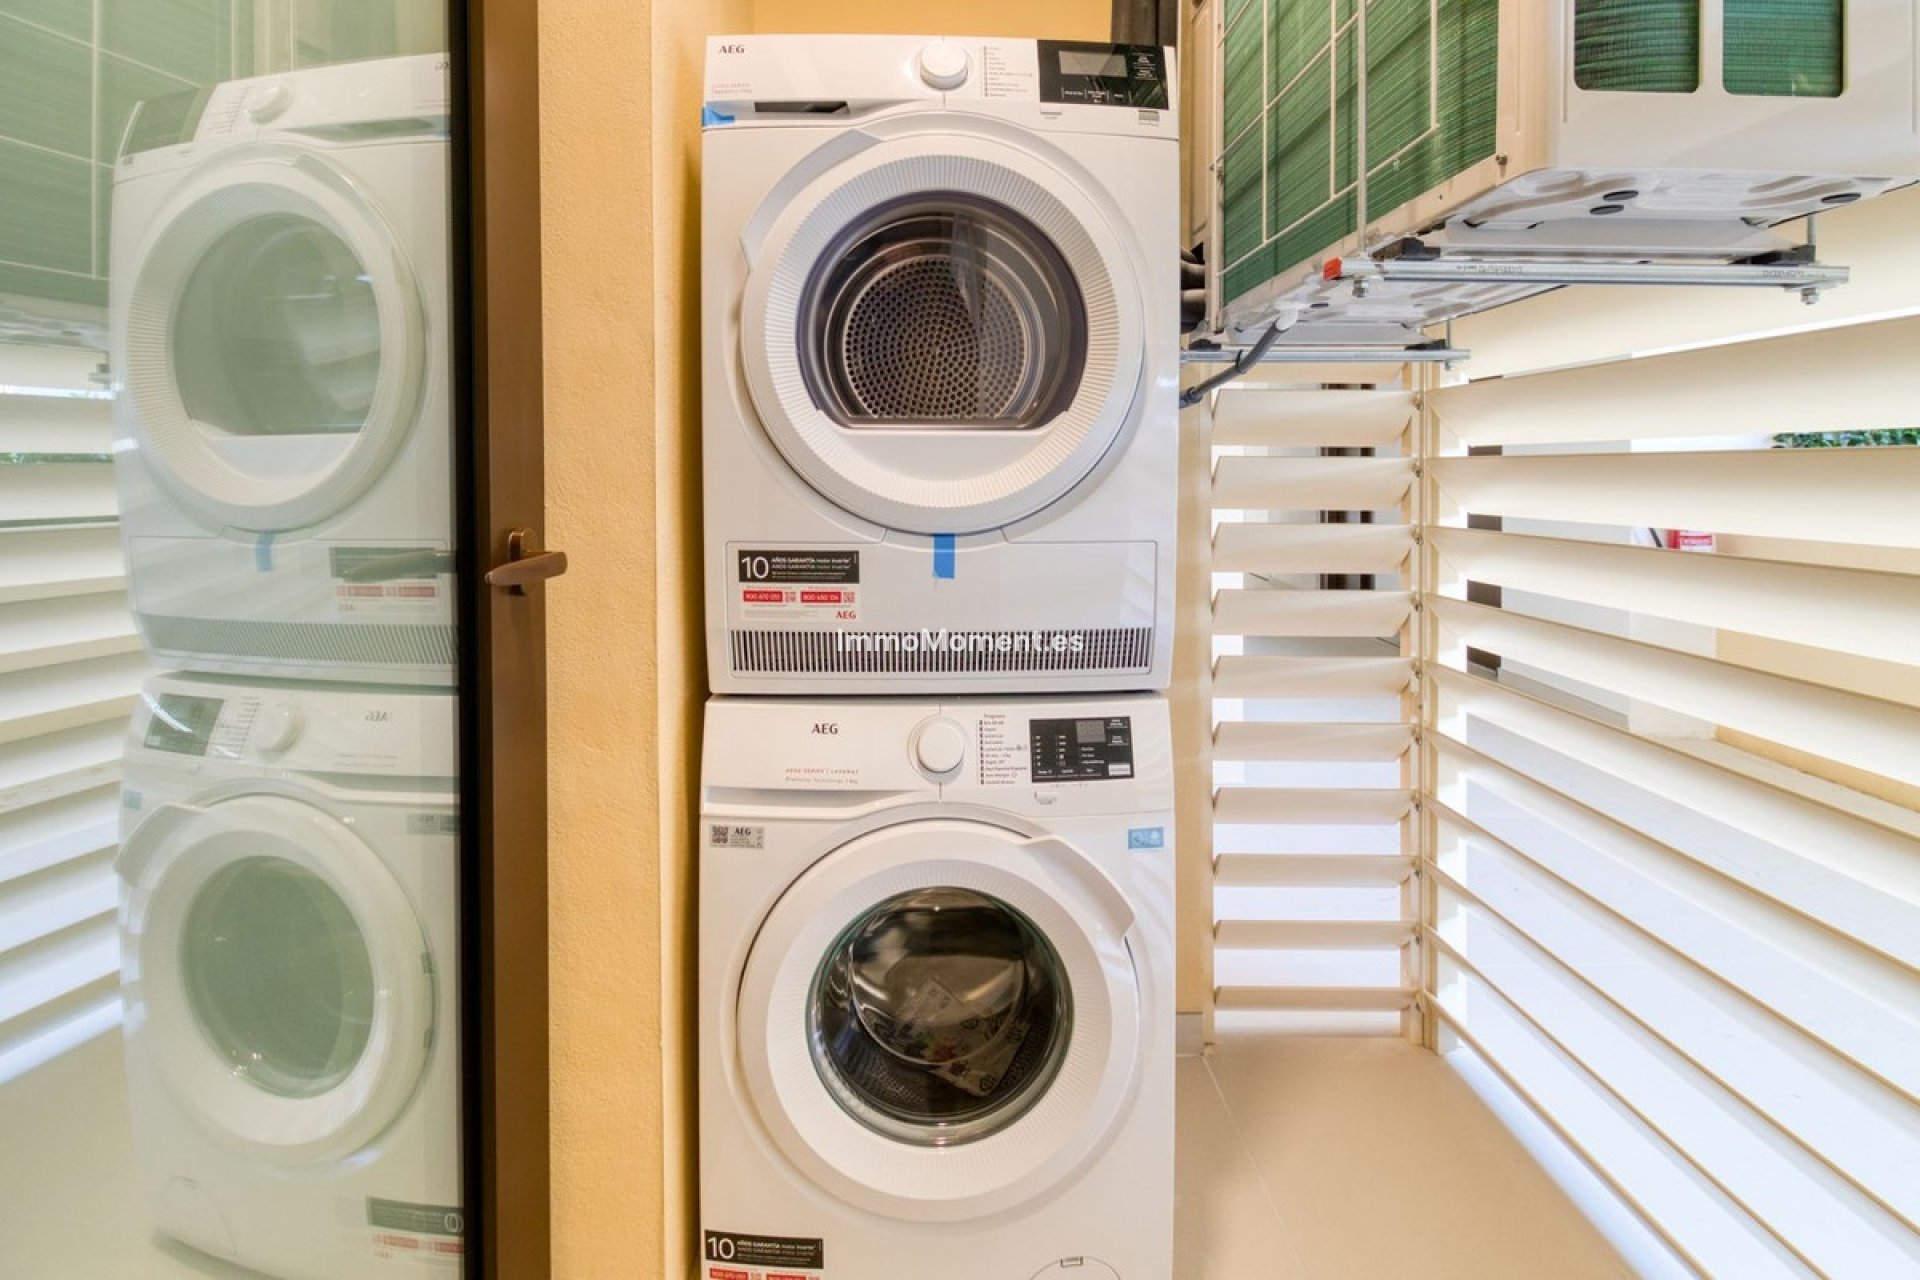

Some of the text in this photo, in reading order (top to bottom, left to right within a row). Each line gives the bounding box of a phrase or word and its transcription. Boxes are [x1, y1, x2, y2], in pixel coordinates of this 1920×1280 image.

[718, 44, 745, 54] AEG
[741, 556, 769, 579] 10
[836, 610, 857, 620] AEG
[811, 722, 839, 735] AEG
[734, 826, 752, 836] AEG
[707, 1236, 735, 1260] 10
